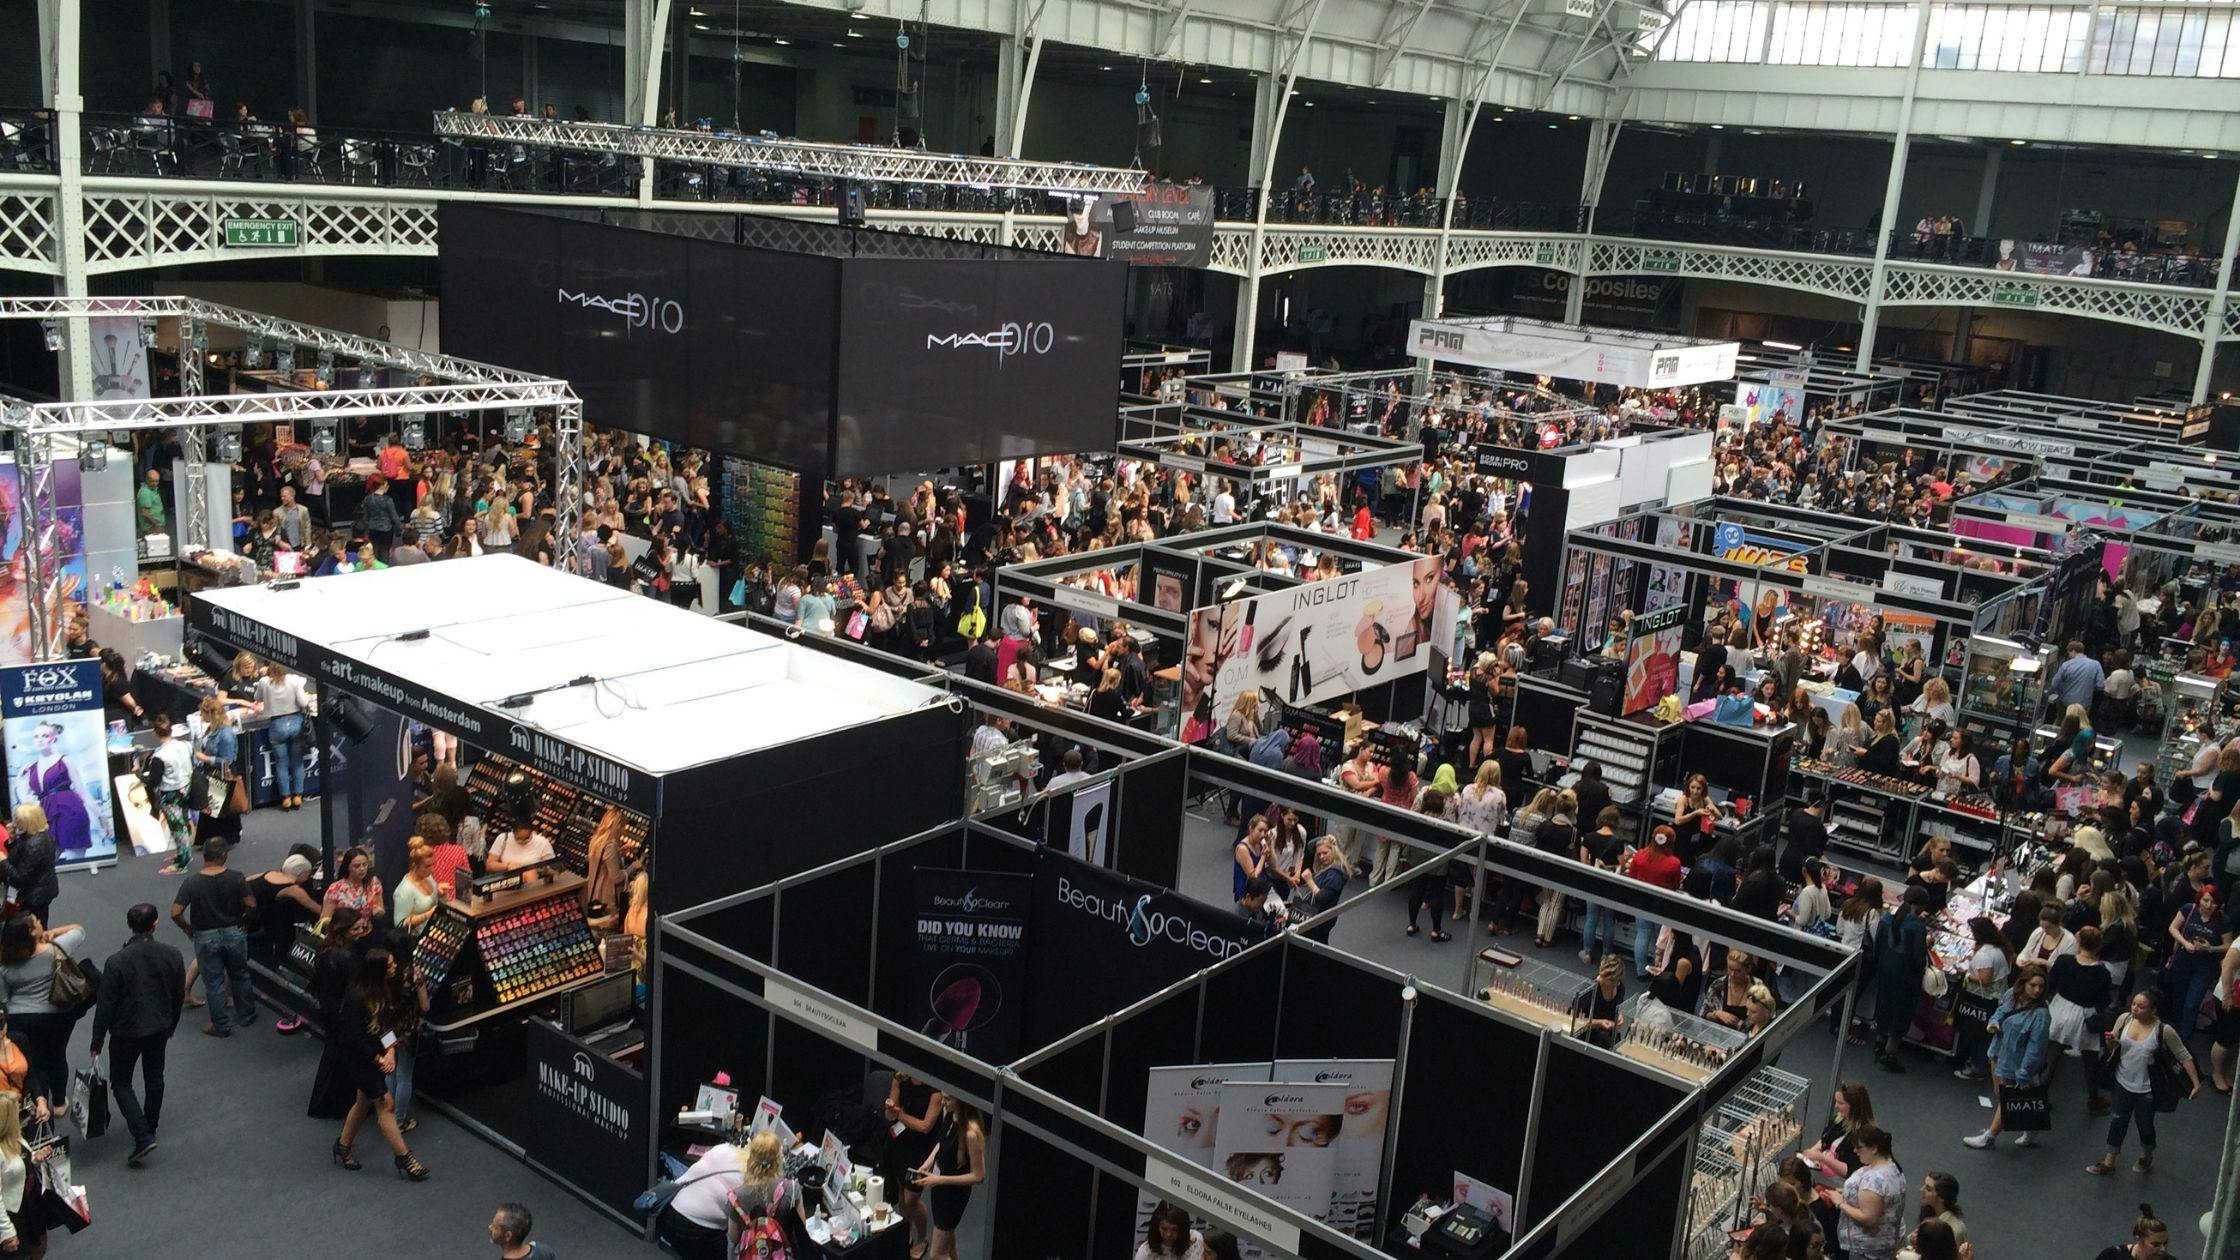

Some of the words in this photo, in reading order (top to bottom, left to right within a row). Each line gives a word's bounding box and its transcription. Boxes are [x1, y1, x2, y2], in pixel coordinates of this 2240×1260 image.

[228, 222, 276, 230] EMERGENCY
[1156, 226, 1179, 235] MUSEUM
[1112, 240, 1136, 249] STUDENT
[1136, 241, 1171, 250] COMPETITION
[1172, 242, 1196, 251] PLATFORM
[2027, 243, 2065, 255] IMATS
[1543, 272, 1661, 301] Coposites
[1984, 436, 2005, 447] BEST
[2040, 445, 2071, 455] DEALS
[1503, 458, 1529, 471] PRO
[1293, 579, 1360, 611] INGLOT
[1640, 609, 1681, 631] INGLOT
[229, 613, 266, 645] MAKE-UP
[266, 628, 297, 658] STUDIO
[22, 665, 79, 688] FOX
[25, 690, 93, 704] KRYOLAN
[320, 660, 331, 673] the
[331, 660, 353, 682] art
[352, 673, 361, 685] of
[360, 674, 405, 705] makeup
[404, 693, 421, 709] from
[421, 697, 482, 733] Amsterdam
[32, 703, 76, 714] LONDON
[535, 733, 585, 773] MAKE-UP
[587, 754, 629, 792] STUDIO
[917, 920, 942, 935] DID
[944, 921, 974, 937] YOU
[977, 924, 1023, 940] KNOW
[1959, 1004, 1988, 1021] IMATS
[538, 1083, 591, 1119] PROFESSIONAL
[539, 1061, 588, 1106] MAKE-UP
[590, 1090, 629, 1131] STUDIO
[2006, 1100, 2045, 1110] IMATS
[1186, 1184, 1212, 1203] ELDORA
[1212, 1197, 1233, 1214] FALSE
[1233, 1206, 1272, 1232] EYELASHES
